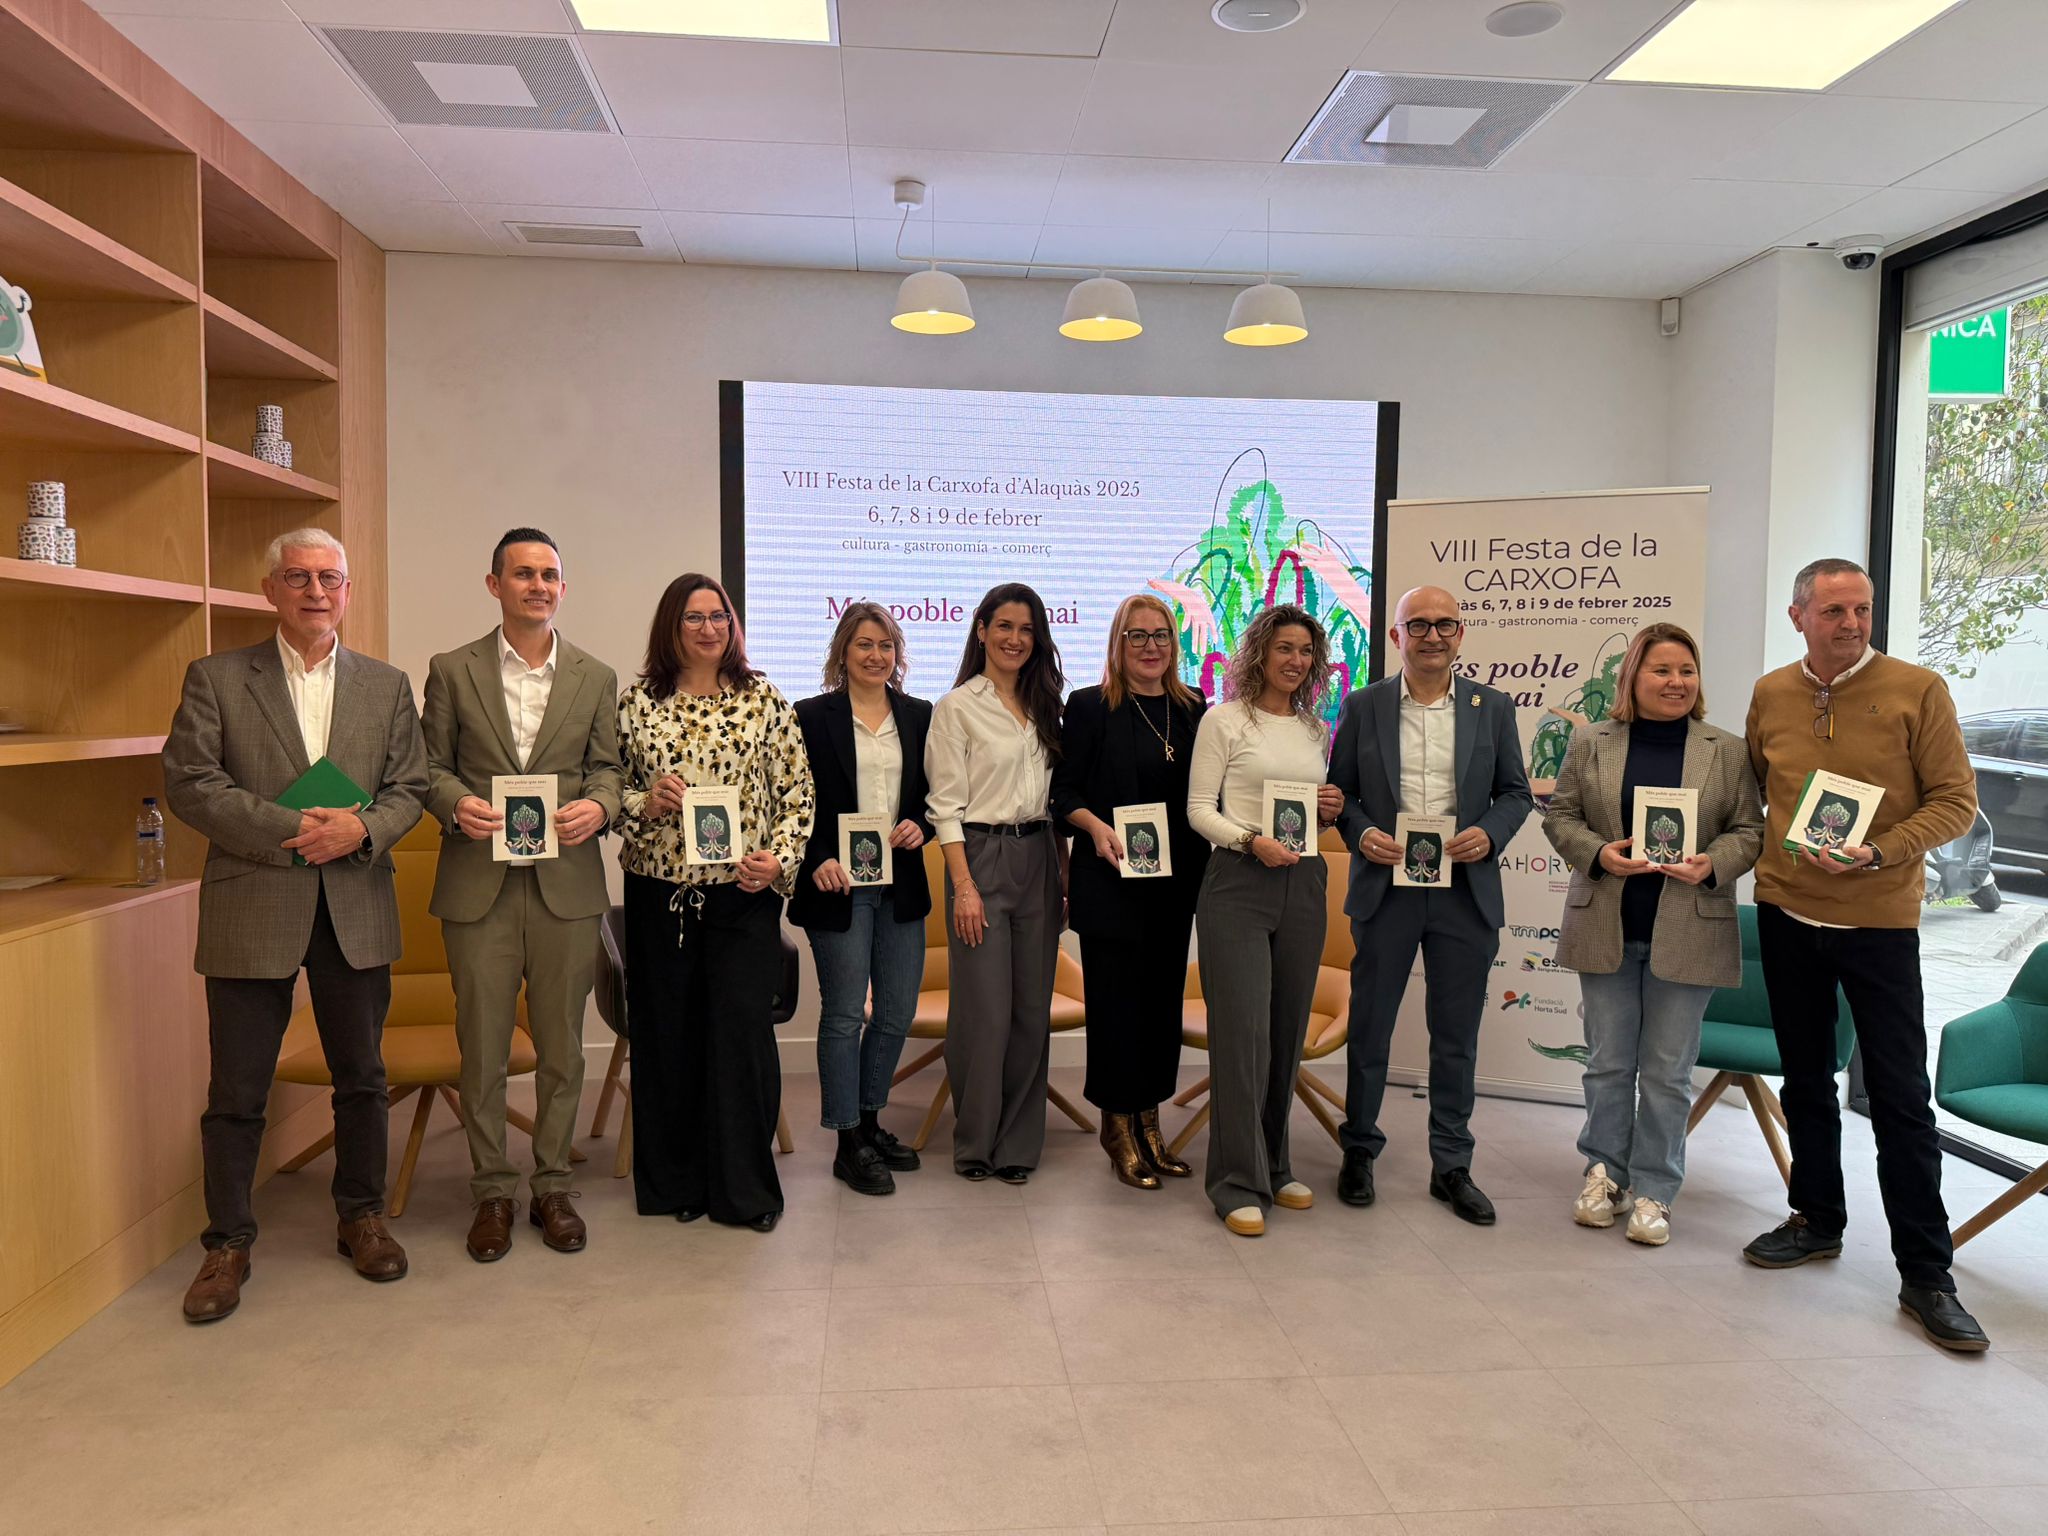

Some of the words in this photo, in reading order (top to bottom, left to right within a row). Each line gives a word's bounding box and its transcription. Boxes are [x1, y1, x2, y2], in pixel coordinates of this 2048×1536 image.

[782, 471, 819, 489] VIII
[826, 472, 872, 491] Festa
[878, 474, 902, 492] de
[906, 475, 922, 493] la
[927, 475, 1000, 495] Carxofa
[1096, 480, 1141, 498] 2025
[868, 506, 885, 527] 6,
[890, 507, 904, 527] 7,
[909, 507, 921, 525] 8
[926, 507, 933, 525] i
[938, 508, 950, 526] 9
[956, 508, 978, 526] de
[984, 508, 1043, 528] febrer
[842, 537, 890, 551] cultura
[1002, 543, 1052, 557] comerç
[1430, 539, 1477, 563] VIII
[1489, 538, 1571, 561] Festa
[1581, 534, 1622, 559] de
[1633, 532, 1658, 557] la
[1464, 566, 1621, 592] CARXOFA
[888, 597, 964, 622] poble
[1482, 599, 1496, 613] 6,
[1499, 598, 1512, 612] 7,
[1516, 598, 1526, 610] 8
[1530, 597, 1535, 610] i
[1539, 598, 1550, 610] 9
[1553, 597, 1574, 610] de
[1578, 596, 1629, 609] febrer
[1632, 596, 1672, 609] 2025
[1498, 615, 1578, 628] gastronomia
[1589, 615, 1639, 627] comerç
[1451, 655, 1480, 678] és
[1485, 653, 1579, 686] poble
[1504, 683, 1544, 707] ai
[1534, 997, 1564, 1006] Fundació
[1534, 1005, 1553, 1013] Horta
[1554, 1007, 1568, 1015] Sud
